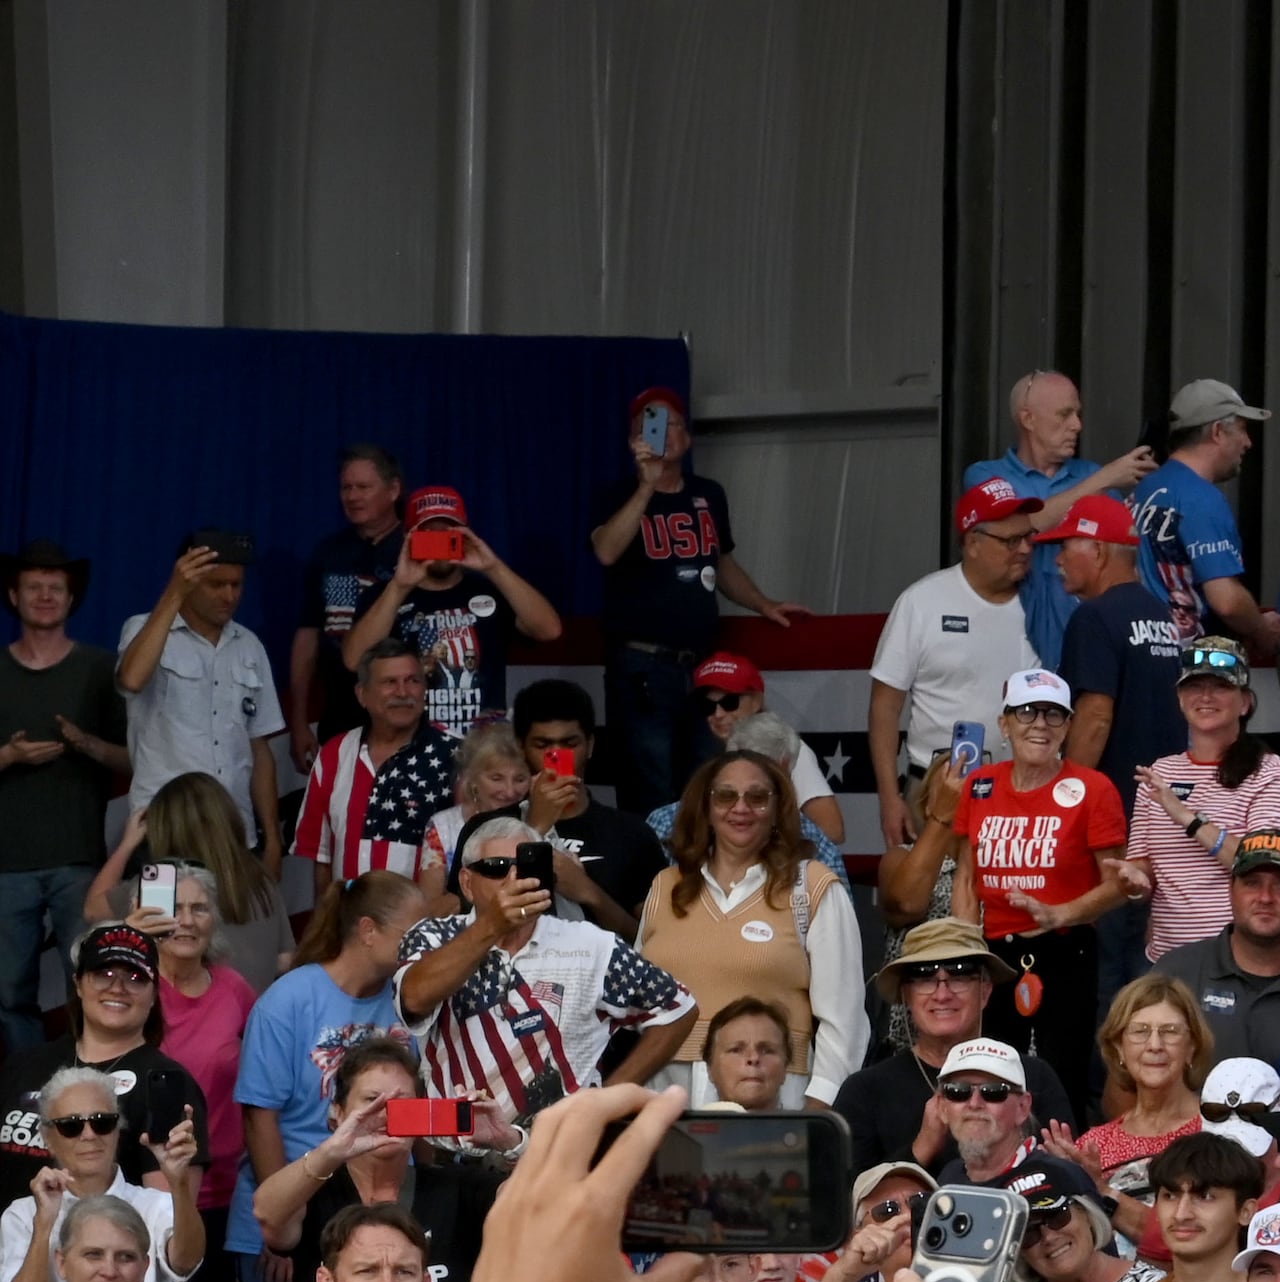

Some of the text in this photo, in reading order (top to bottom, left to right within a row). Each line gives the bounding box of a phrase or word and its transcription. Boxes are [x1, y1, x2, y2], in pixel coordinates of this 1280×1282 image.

[640, 510, 720, 560] USA
[1185, 540, 1231, 560] Trum
[424, 609, 478, 632] TRUMP
[977, 815, 1062, 841] SHUT UP
[977, 838, 1058, 869] DANCE
[983, 874, 1046, 890] SAN ANTONIO
[959, 1045, 1007, 1058] TRUMP
[5, 1109, 41, 1130] GE
[1007, 1172, 1047, 1198] UMP
